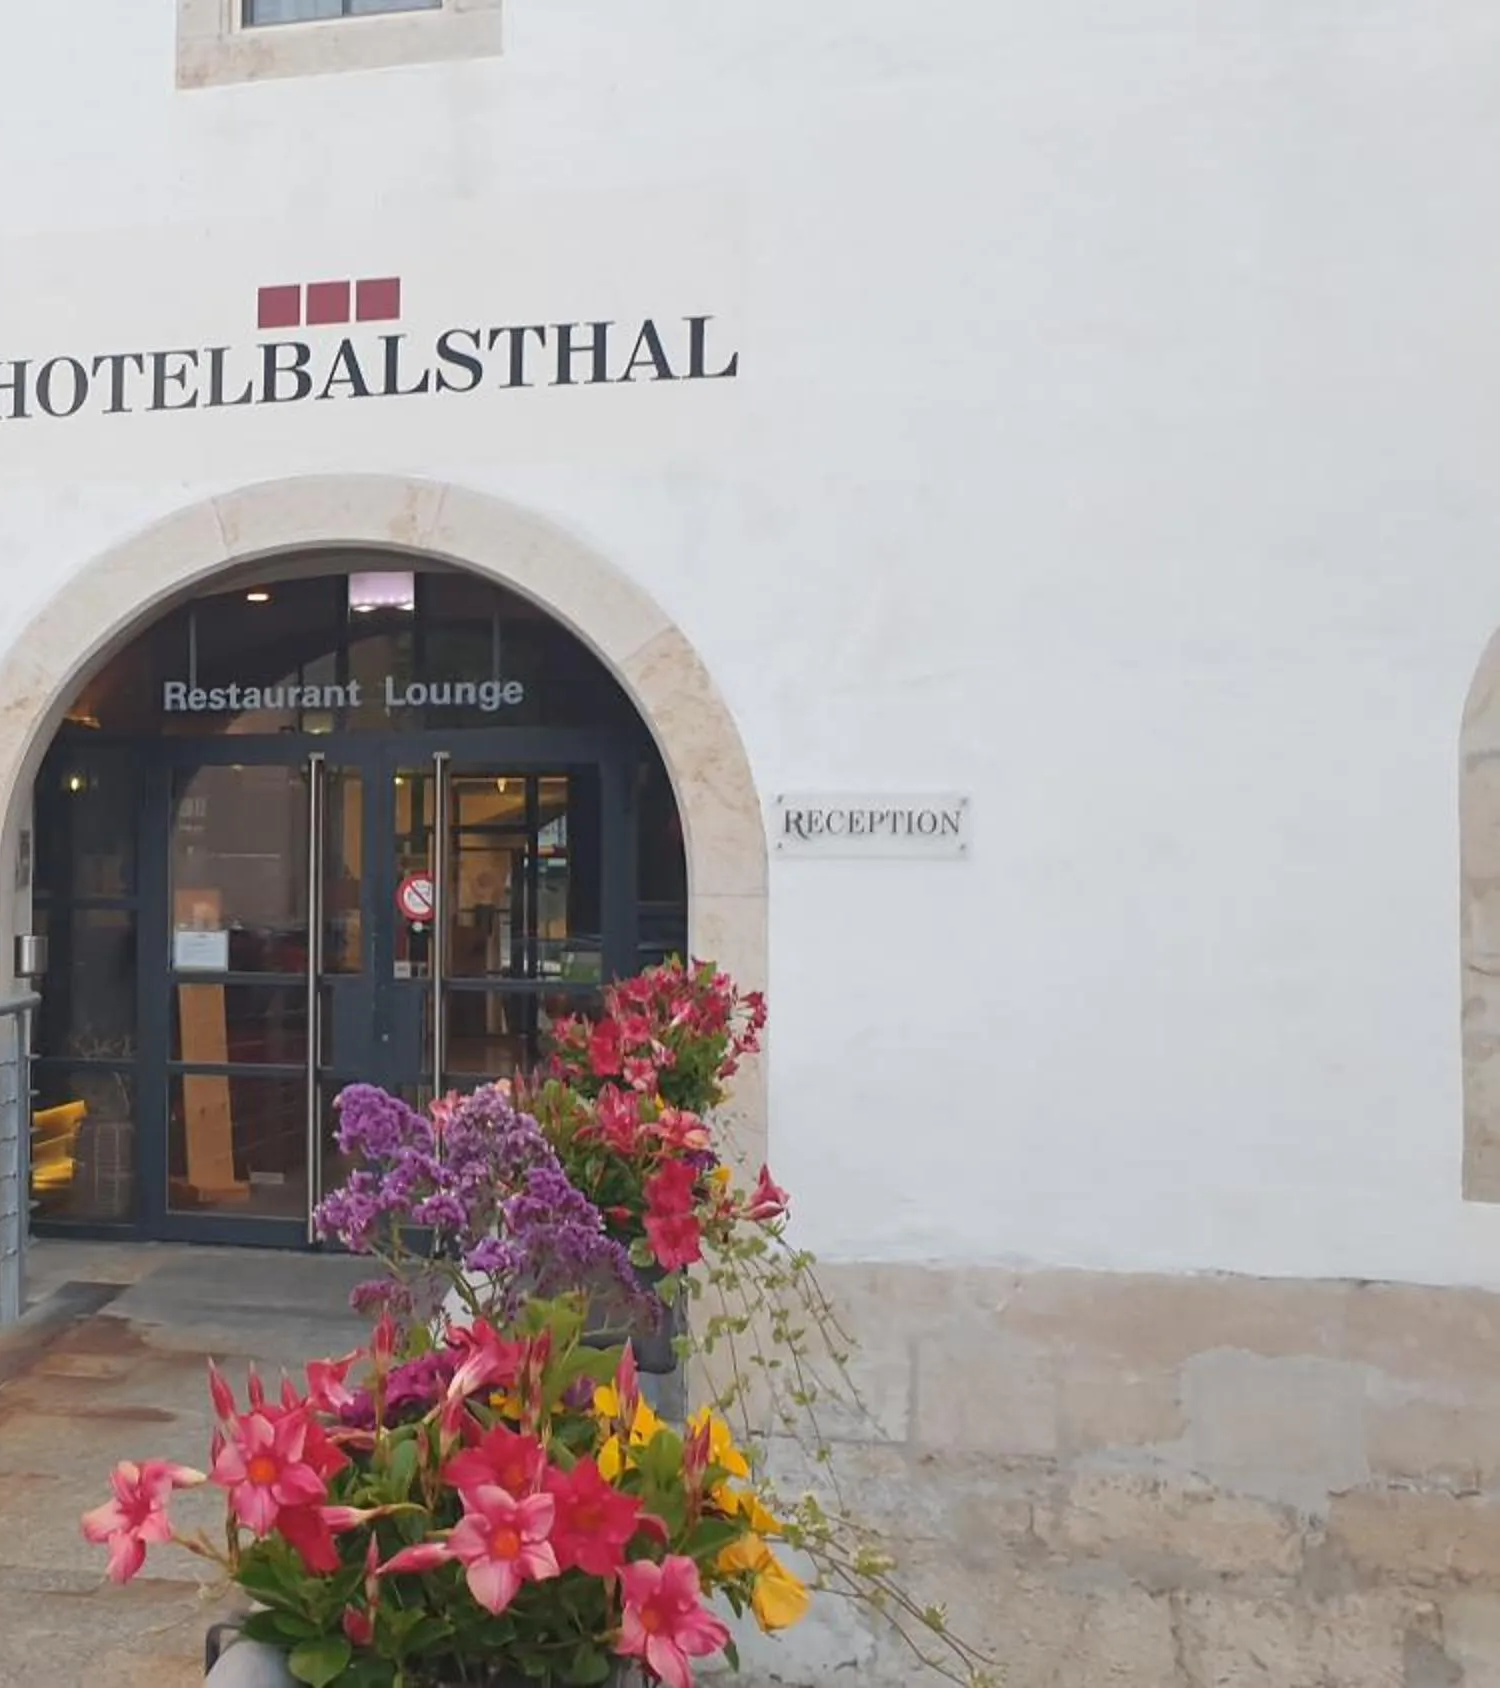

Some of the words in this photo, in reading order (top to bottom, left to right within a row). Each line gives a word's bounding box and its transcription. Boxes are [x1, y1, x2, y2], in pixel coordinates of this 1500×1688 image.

[163, 679, 362, 712] Restaurant
[384, 675, 525, 712] Lounge
[784, 808, 962, 841] RECEPTION
